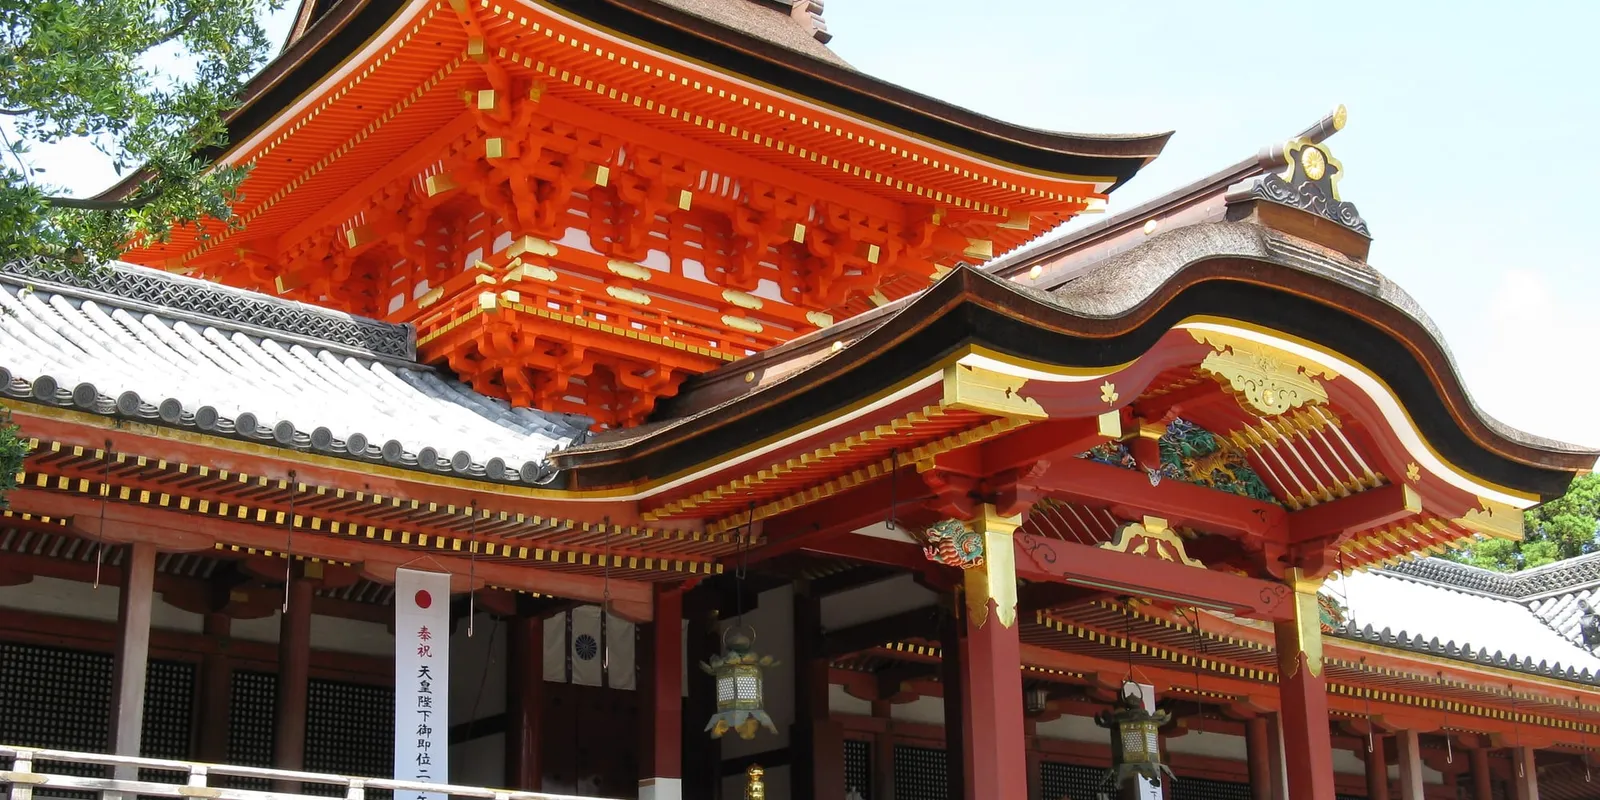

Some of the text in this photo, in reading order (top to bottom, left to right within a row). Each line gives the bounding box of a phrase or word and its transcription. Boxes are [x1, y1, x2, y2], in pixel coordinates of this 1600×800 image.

[415, 625, 433, 800] 奉祝 天皇陛下御即位二
